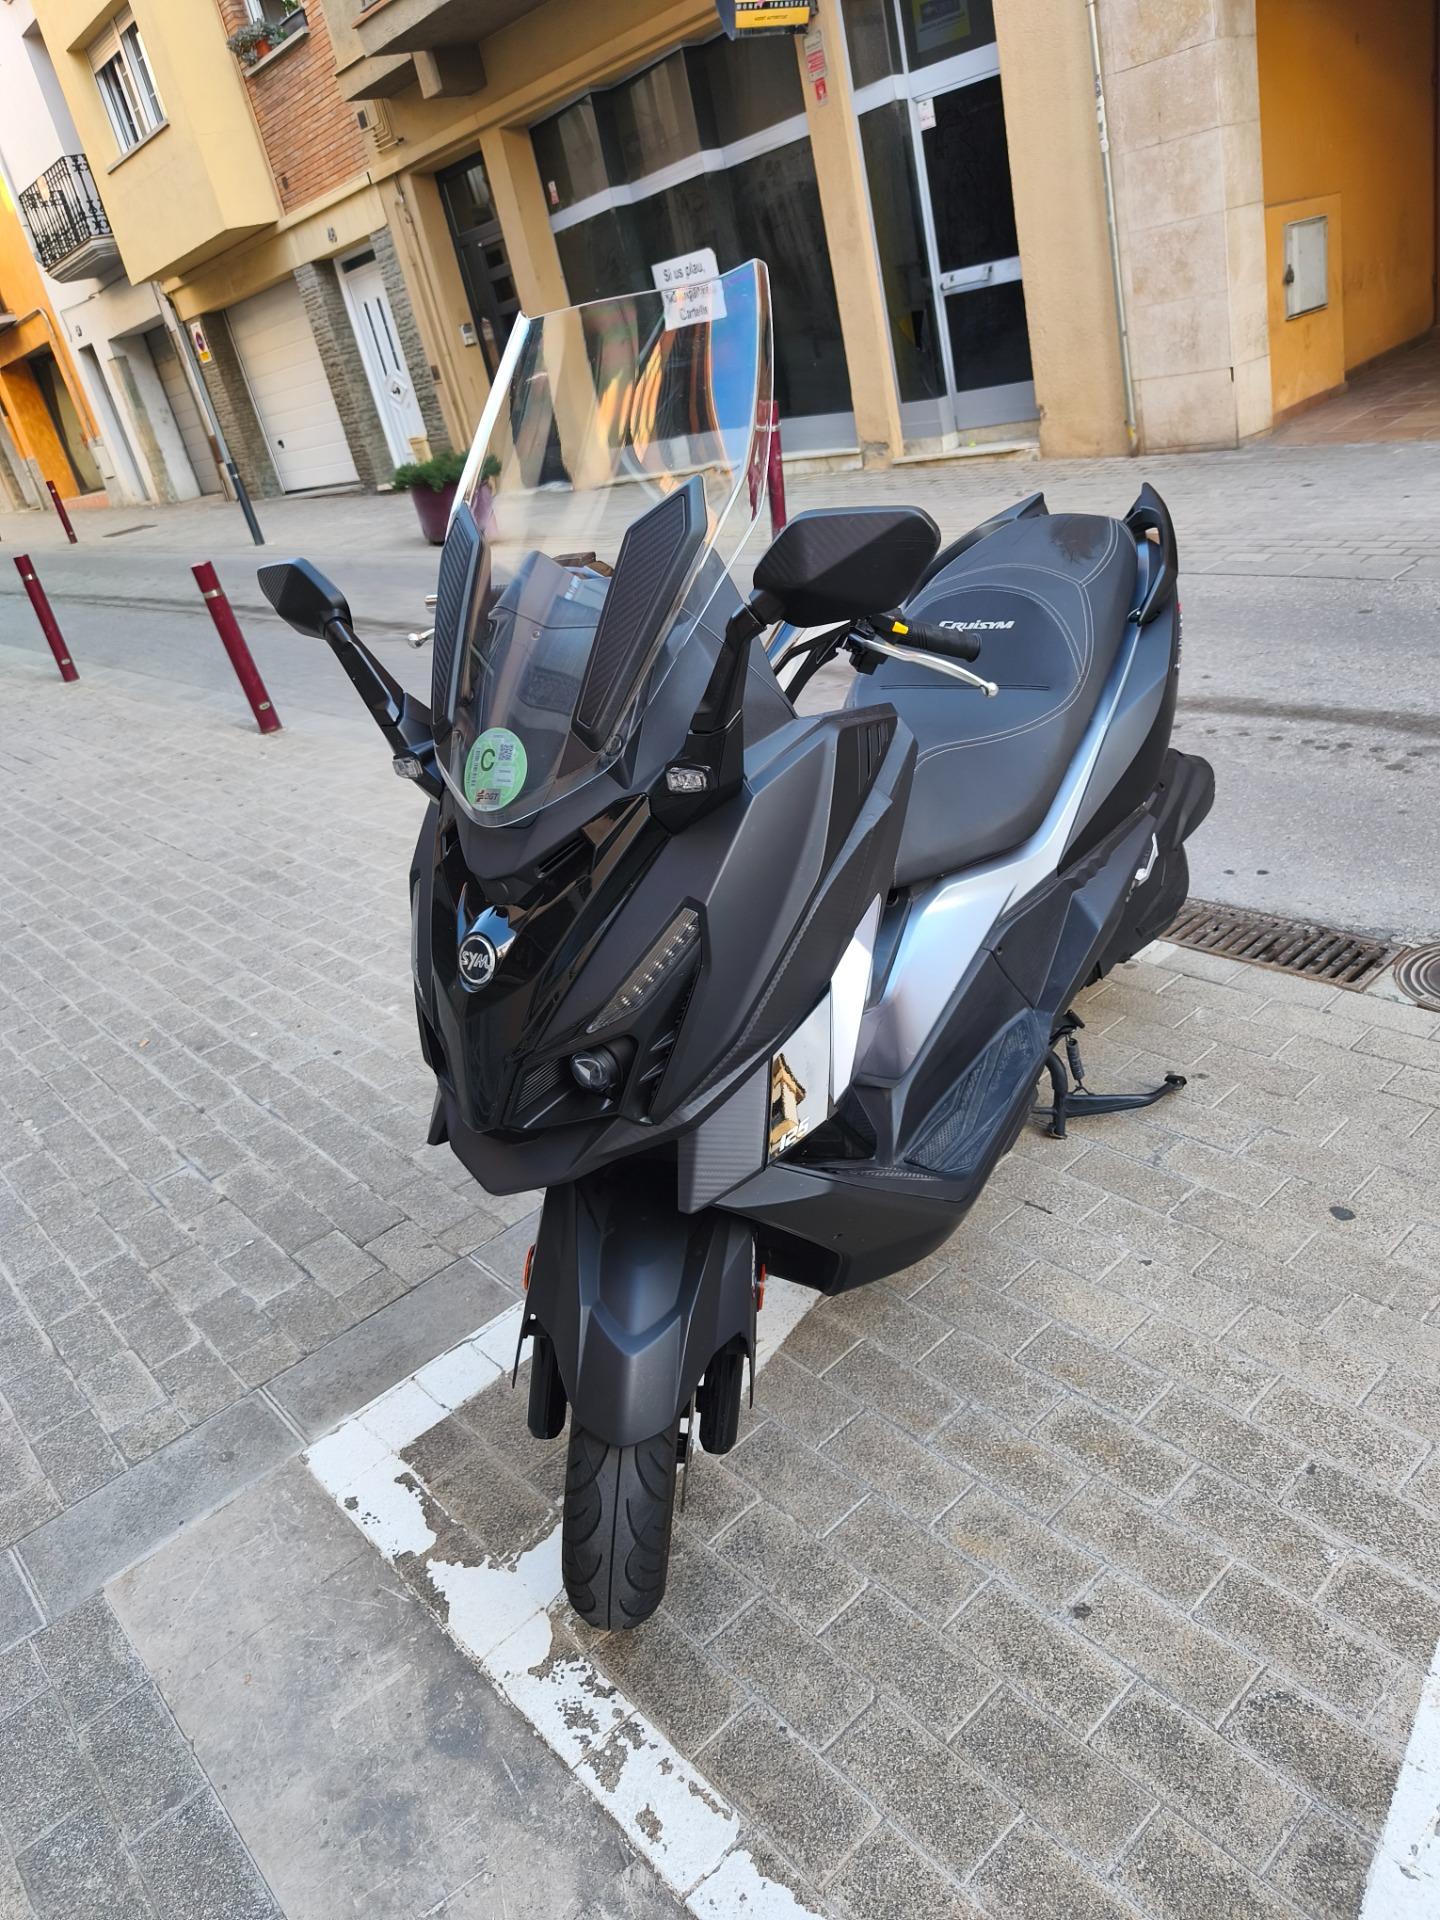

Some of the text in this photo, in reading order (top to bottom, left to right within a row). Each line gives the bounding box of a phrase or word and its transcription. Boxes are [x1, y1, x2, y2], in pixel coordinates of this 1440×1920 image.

[481, 748, 495, 772] C
[461, 950, 491, 971] SYM
[779, 1116, 810, 1152] 125
